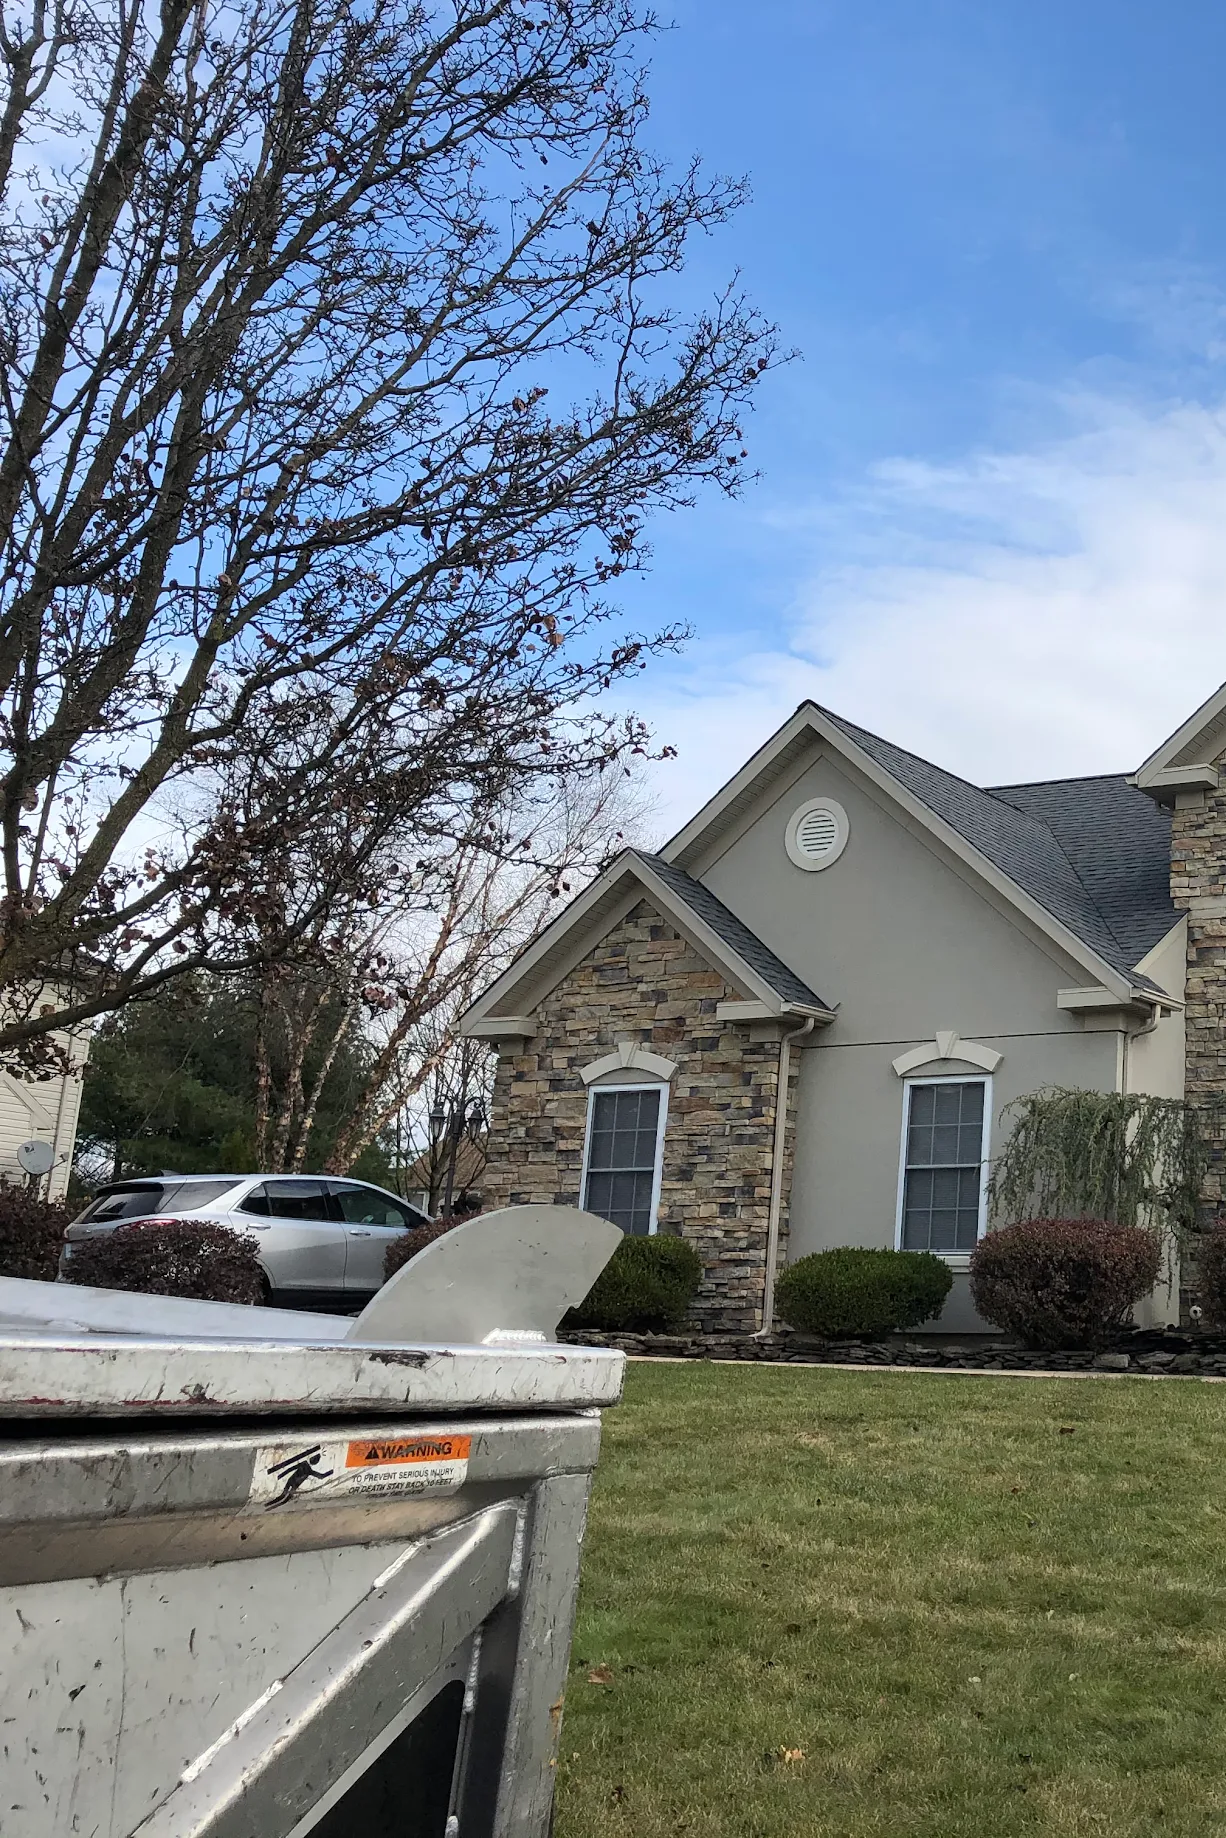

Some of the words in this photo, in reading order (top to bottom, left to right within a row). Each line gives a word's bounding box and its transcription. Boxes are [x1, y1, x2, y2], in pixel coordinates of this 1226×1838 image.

[382, 1442, 452, 1459] WARNING
[352, 1474, 362, 1483] TO
[364, 1472, 397, 1482] PREVENT
[399, 1470, 428, 1479] SERIOUS
[430, 1467, 454, 1477] INJURY
[348, 1486, 361, 1495] OR
[361, 1483, 385, 1493] DEATH
[386, 1482, 405, 1491] STAY
[405, 1480, 425, 1489] BACK
[435, 1478, 453, 1486] FEET
